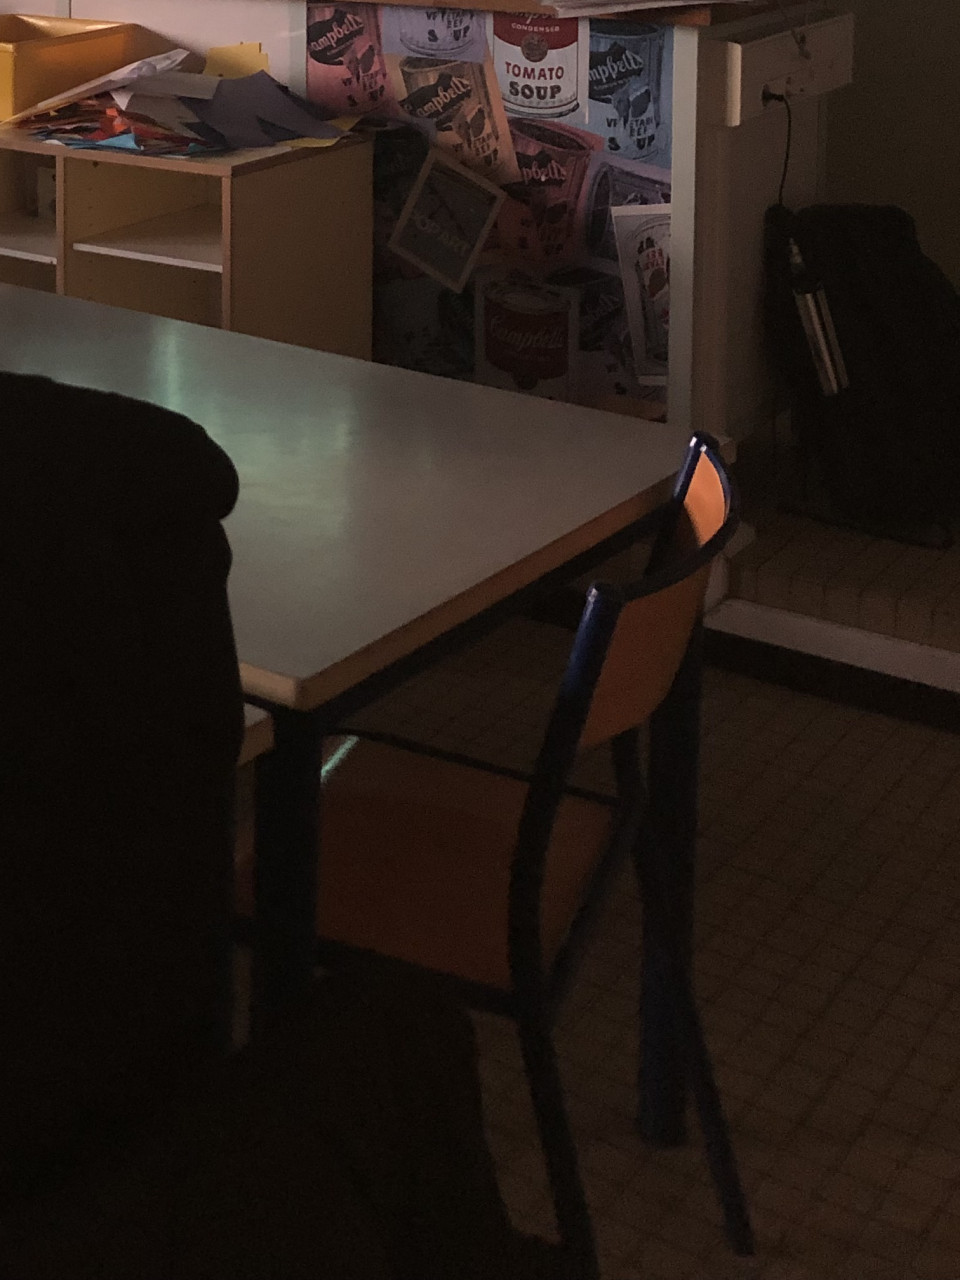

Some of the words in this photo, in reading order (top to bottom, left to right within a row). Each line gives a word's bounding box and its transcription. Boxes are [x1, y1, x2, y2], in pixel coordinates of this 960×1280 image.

[510, 22, 560, 33] CONDENSED
[505, 61, 564, 80] TOMATO
[509, 80, 562, 100] SOUP
